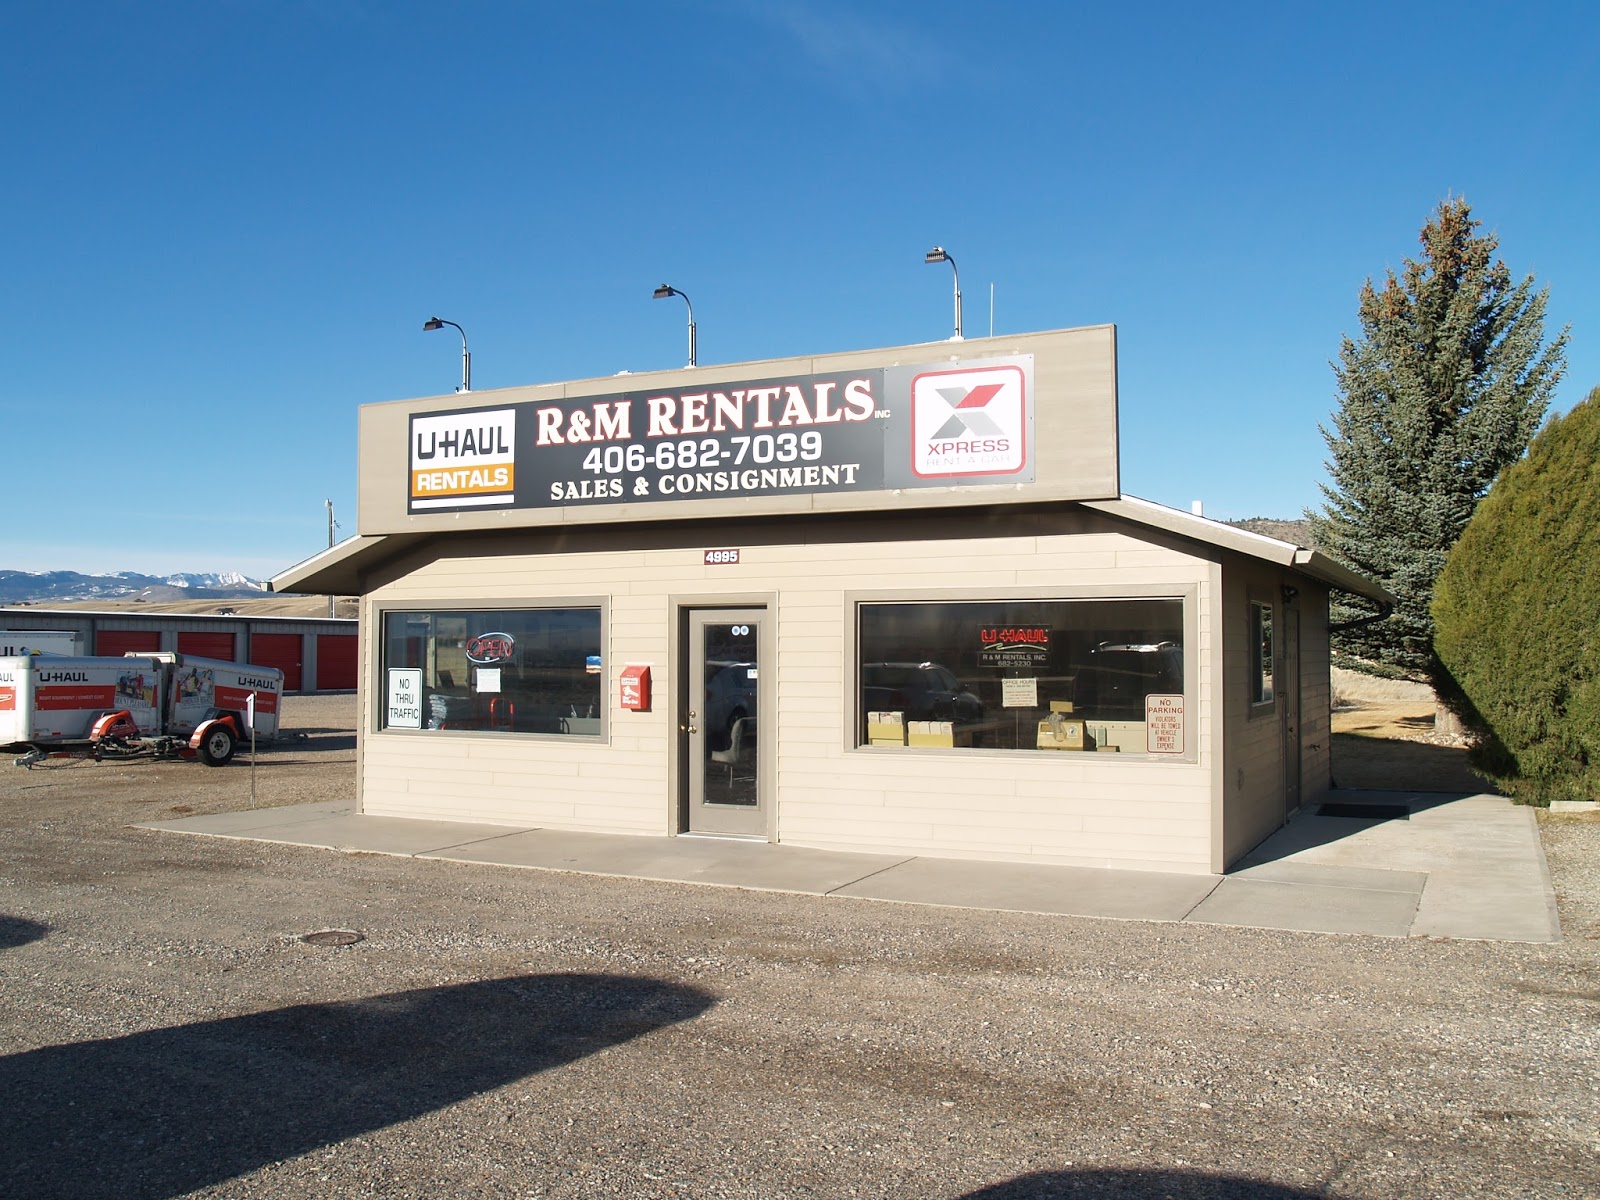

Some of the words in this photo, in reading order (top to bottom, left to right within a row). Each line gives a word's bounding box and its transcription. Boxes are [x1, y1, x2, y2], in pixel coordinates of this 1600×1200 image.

[535, 401, 632, 447] R&M
[647, 379, 875, 438] RENTALS
[874, 409, 891, 419] INC
[417, 426, 509, 460] U-HAUL
[928, 439, 1010, 456] XPRESS
[582, 431, 822, 475] 406-682-7039
[417, 467, 509, 492] RENTALS
[551, 478, 624, 501] SALES
[633, 476, 650, 496] &
[658, 463, 860, 495] CONSIGNMENT
[705, 551, 738, 563] 4995
[981, 628, 1048, 643] U-HAUL
[466, 637, 513, 657] OPEN
[39, 672, 89, 682] U-HAUL
[238, 676, 275, 690] U-HAUL
[399, 678, 410, 690] NO
[395, 693, 414, 705] THRU
[389, 707, 419, 720] TRAFFIC
